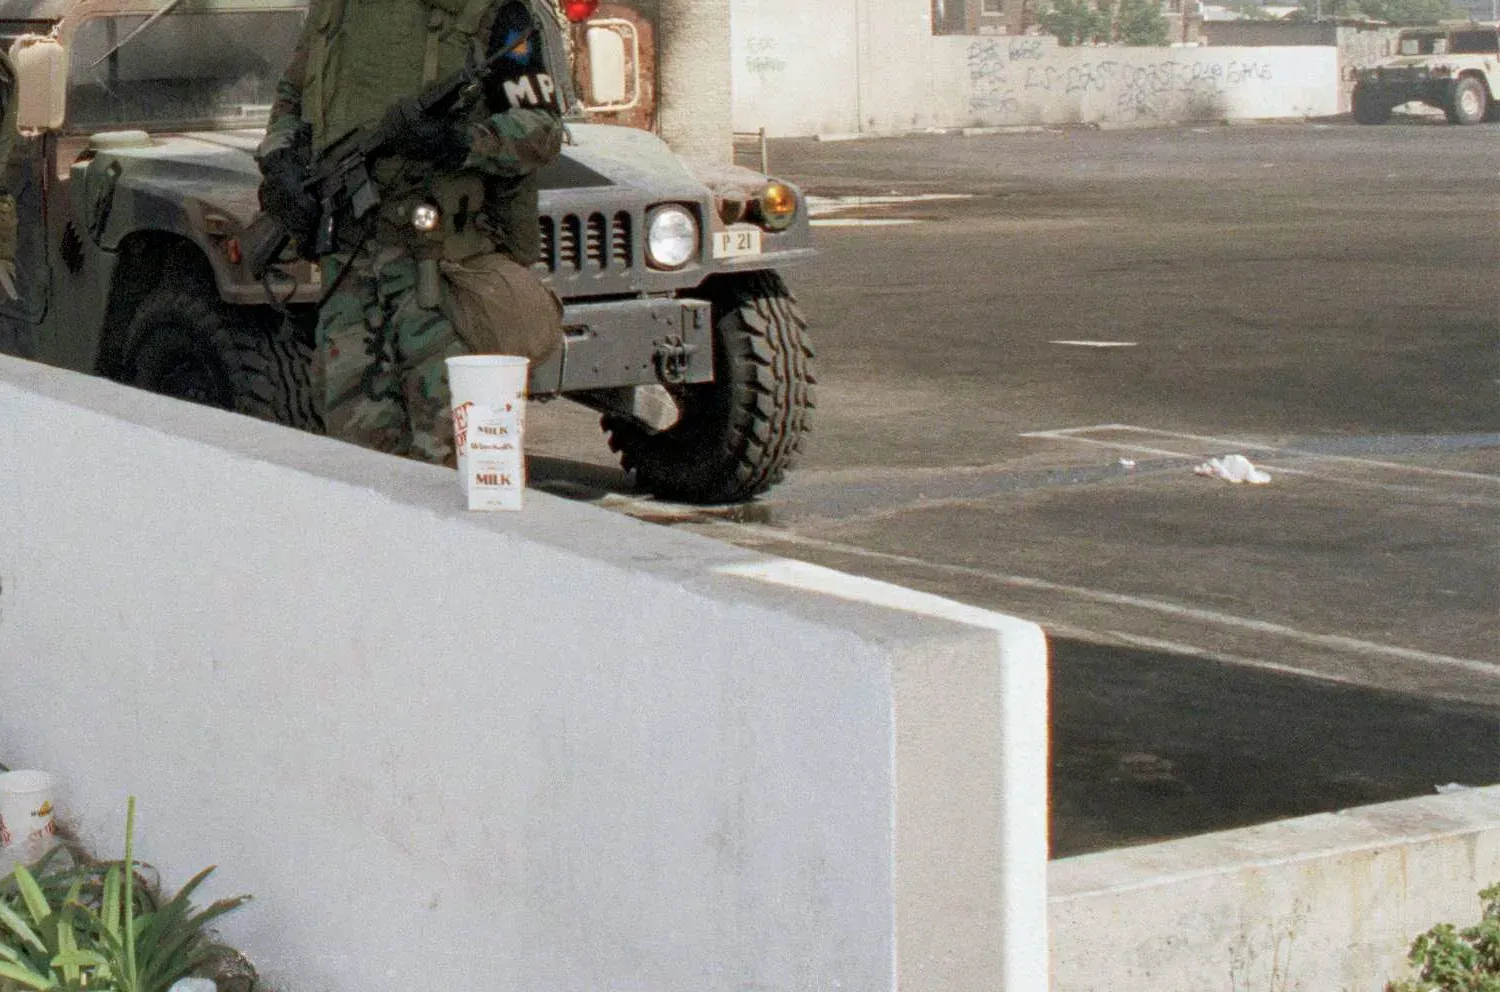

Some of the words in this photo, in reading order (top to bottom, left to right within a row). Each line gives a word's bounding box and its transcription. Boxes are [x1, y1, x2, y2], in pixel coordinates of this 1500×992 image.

[503, 73, 555, 109] MP
[723, 234, 731, 253] P
[737, 233, 751, 251] 21
[475, 473, 511, 487] MILK
